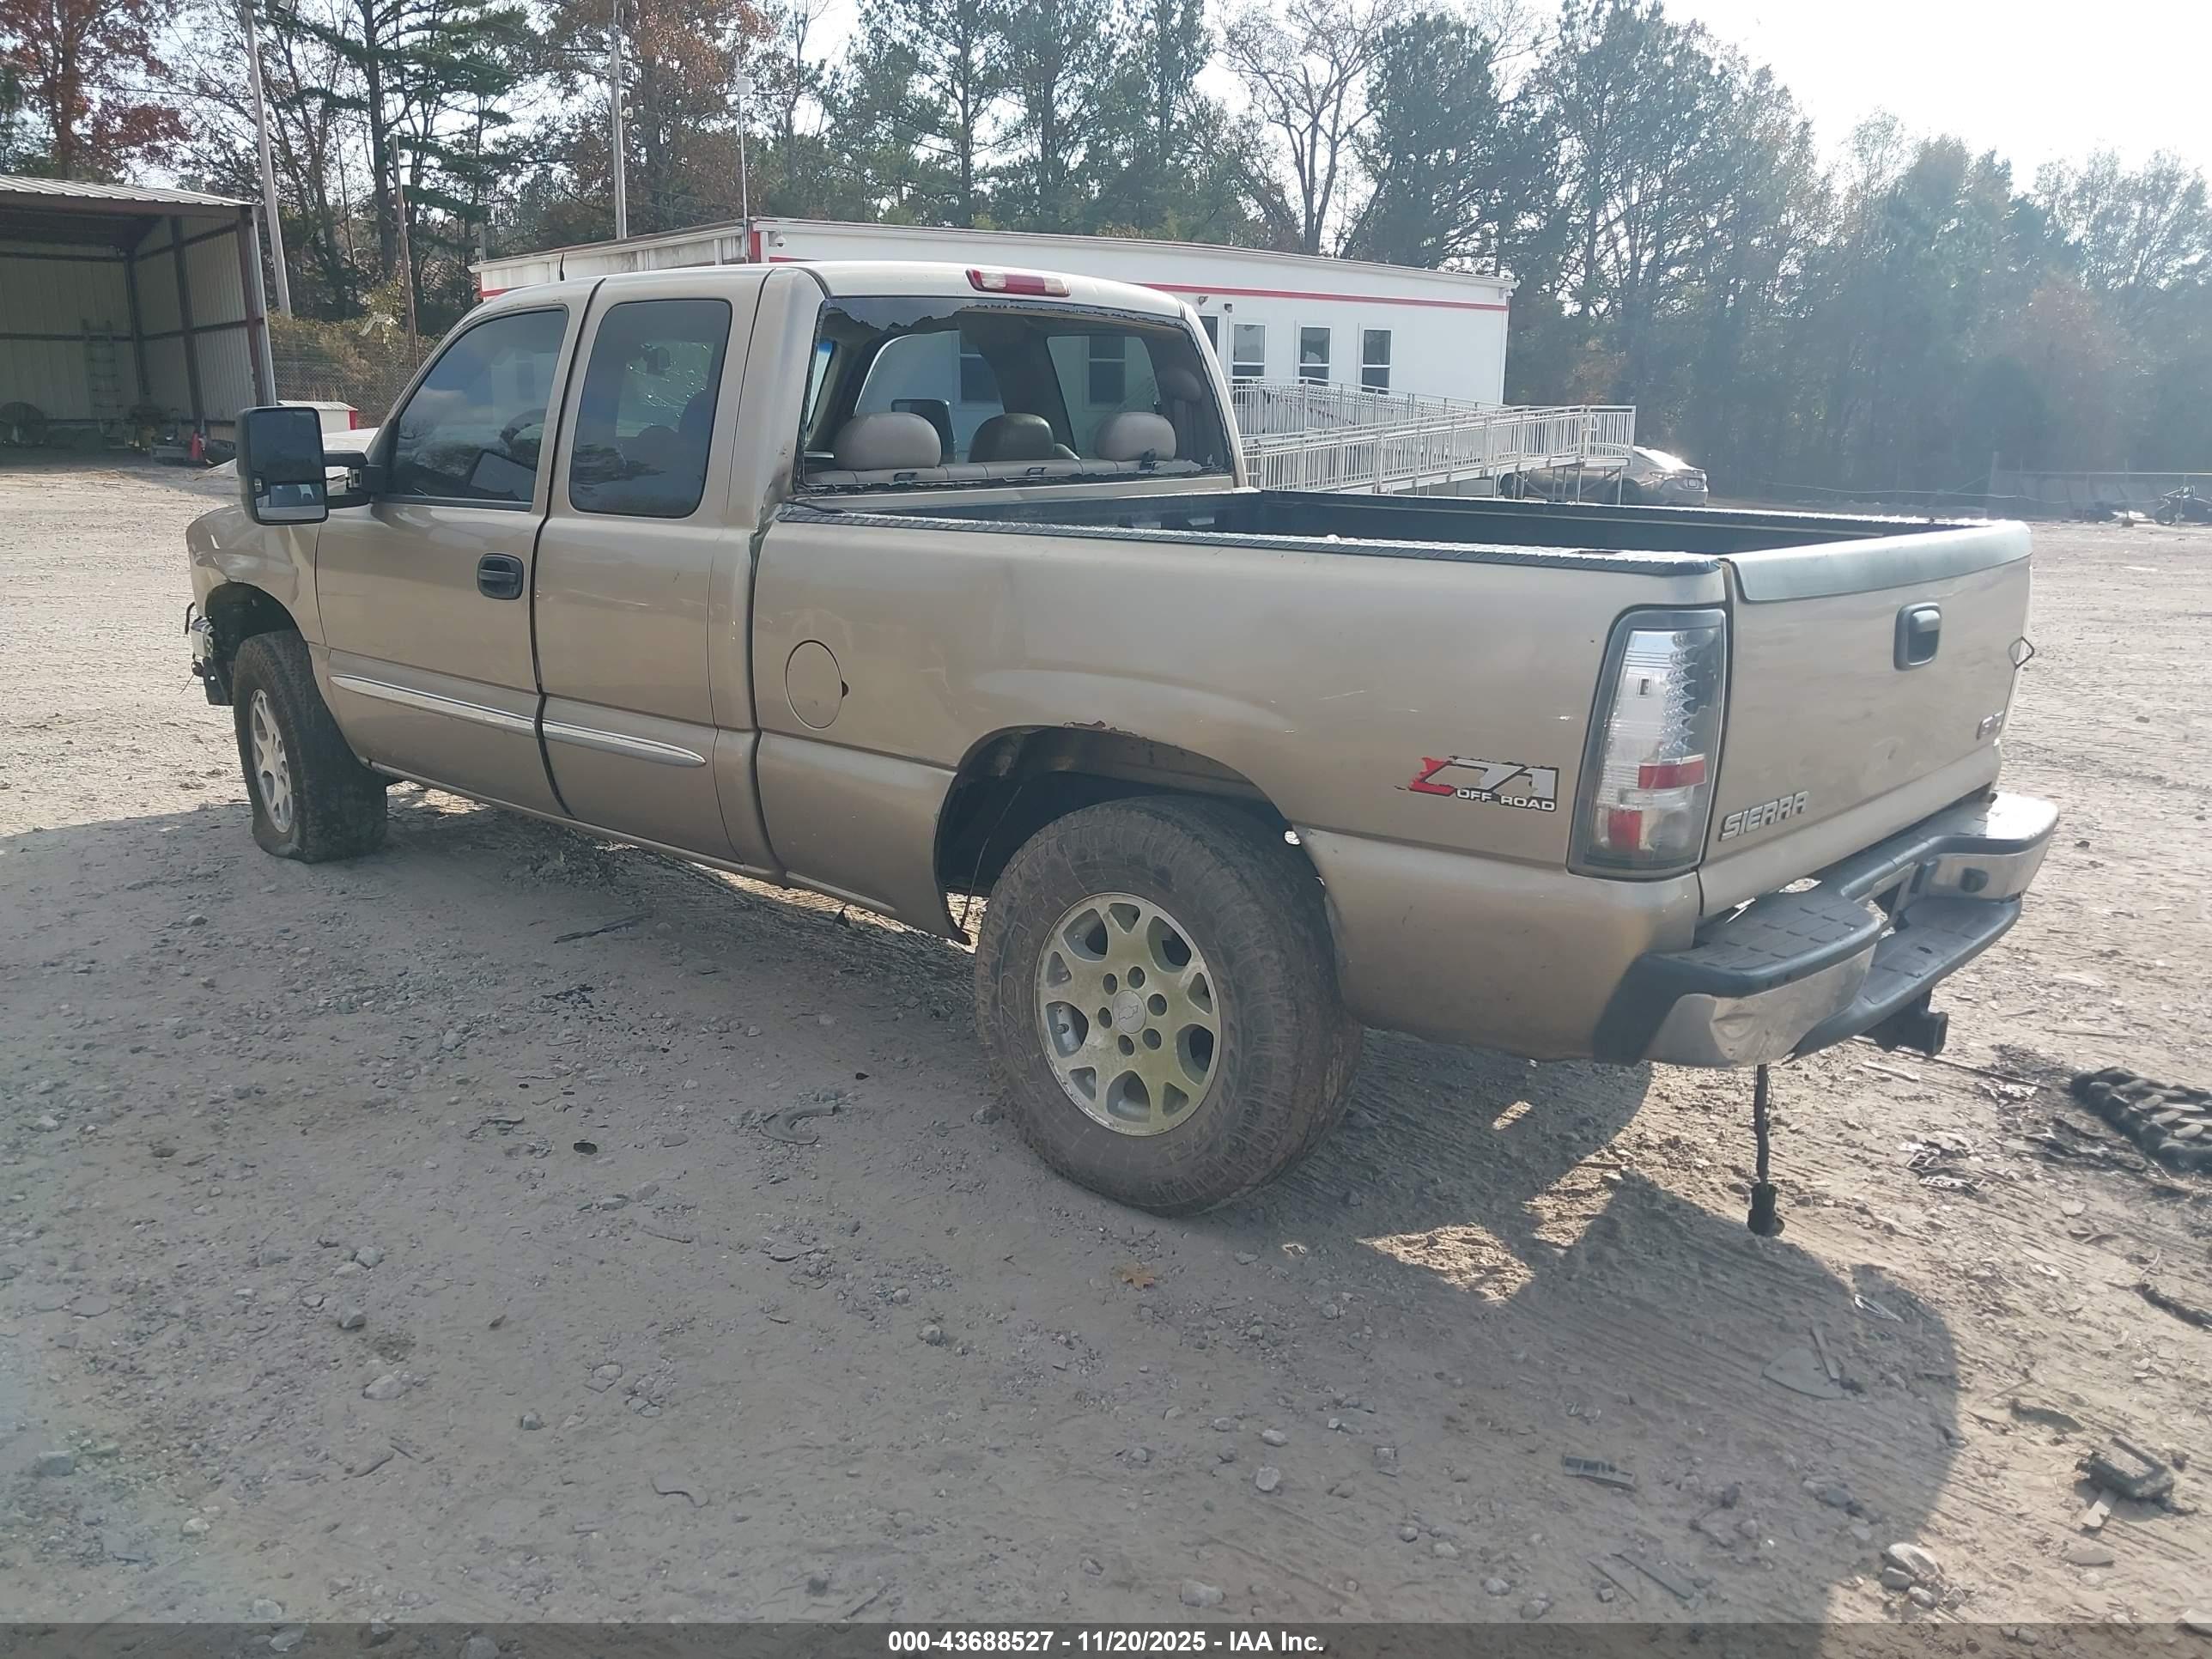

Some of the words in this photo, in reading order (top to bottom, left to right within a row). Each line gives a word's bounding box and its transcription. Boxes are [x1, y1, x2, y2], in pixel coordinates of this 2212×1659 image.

[1408, 756, 1559, 799] Z71
[1456, 788, 1493, 802] OFF
[1500, 794, 1556, 811] ROAD
[1719, 790, 1808, 842] SIERRA
